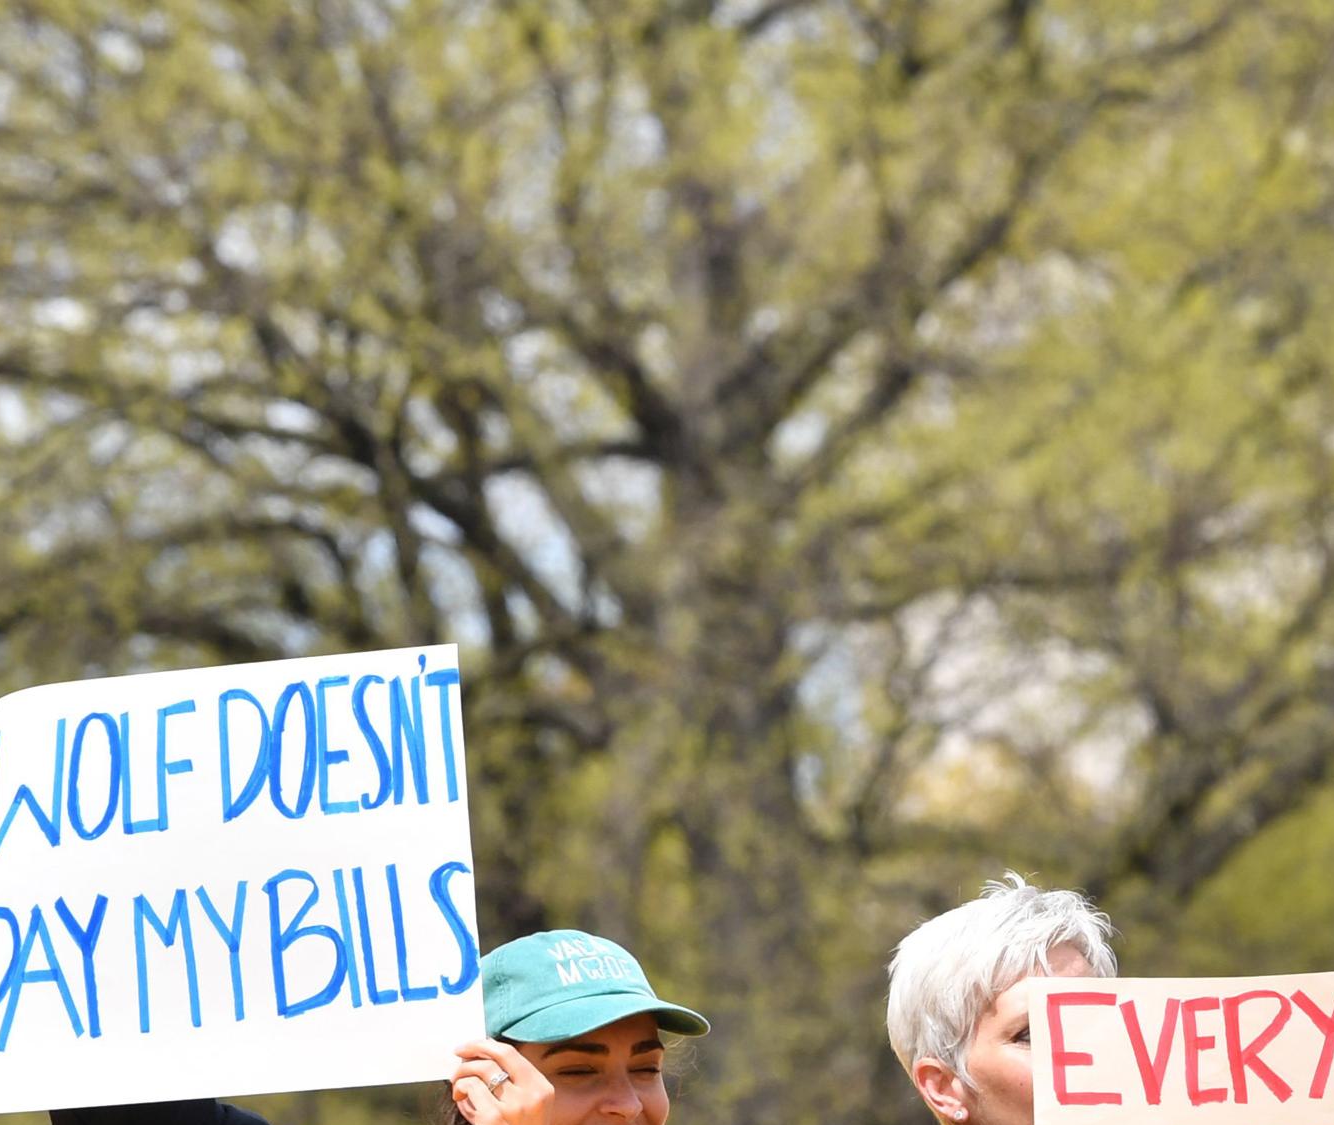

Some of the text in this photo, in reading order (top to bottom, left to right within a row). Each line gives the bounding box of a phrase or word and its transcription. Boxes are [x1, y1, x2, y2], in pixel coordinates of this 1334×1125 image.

[219, 655, 461, 822] DOESN'T
[134, 881, 246, 1033] MY
[263, 862, 479, 1018] BILLS
